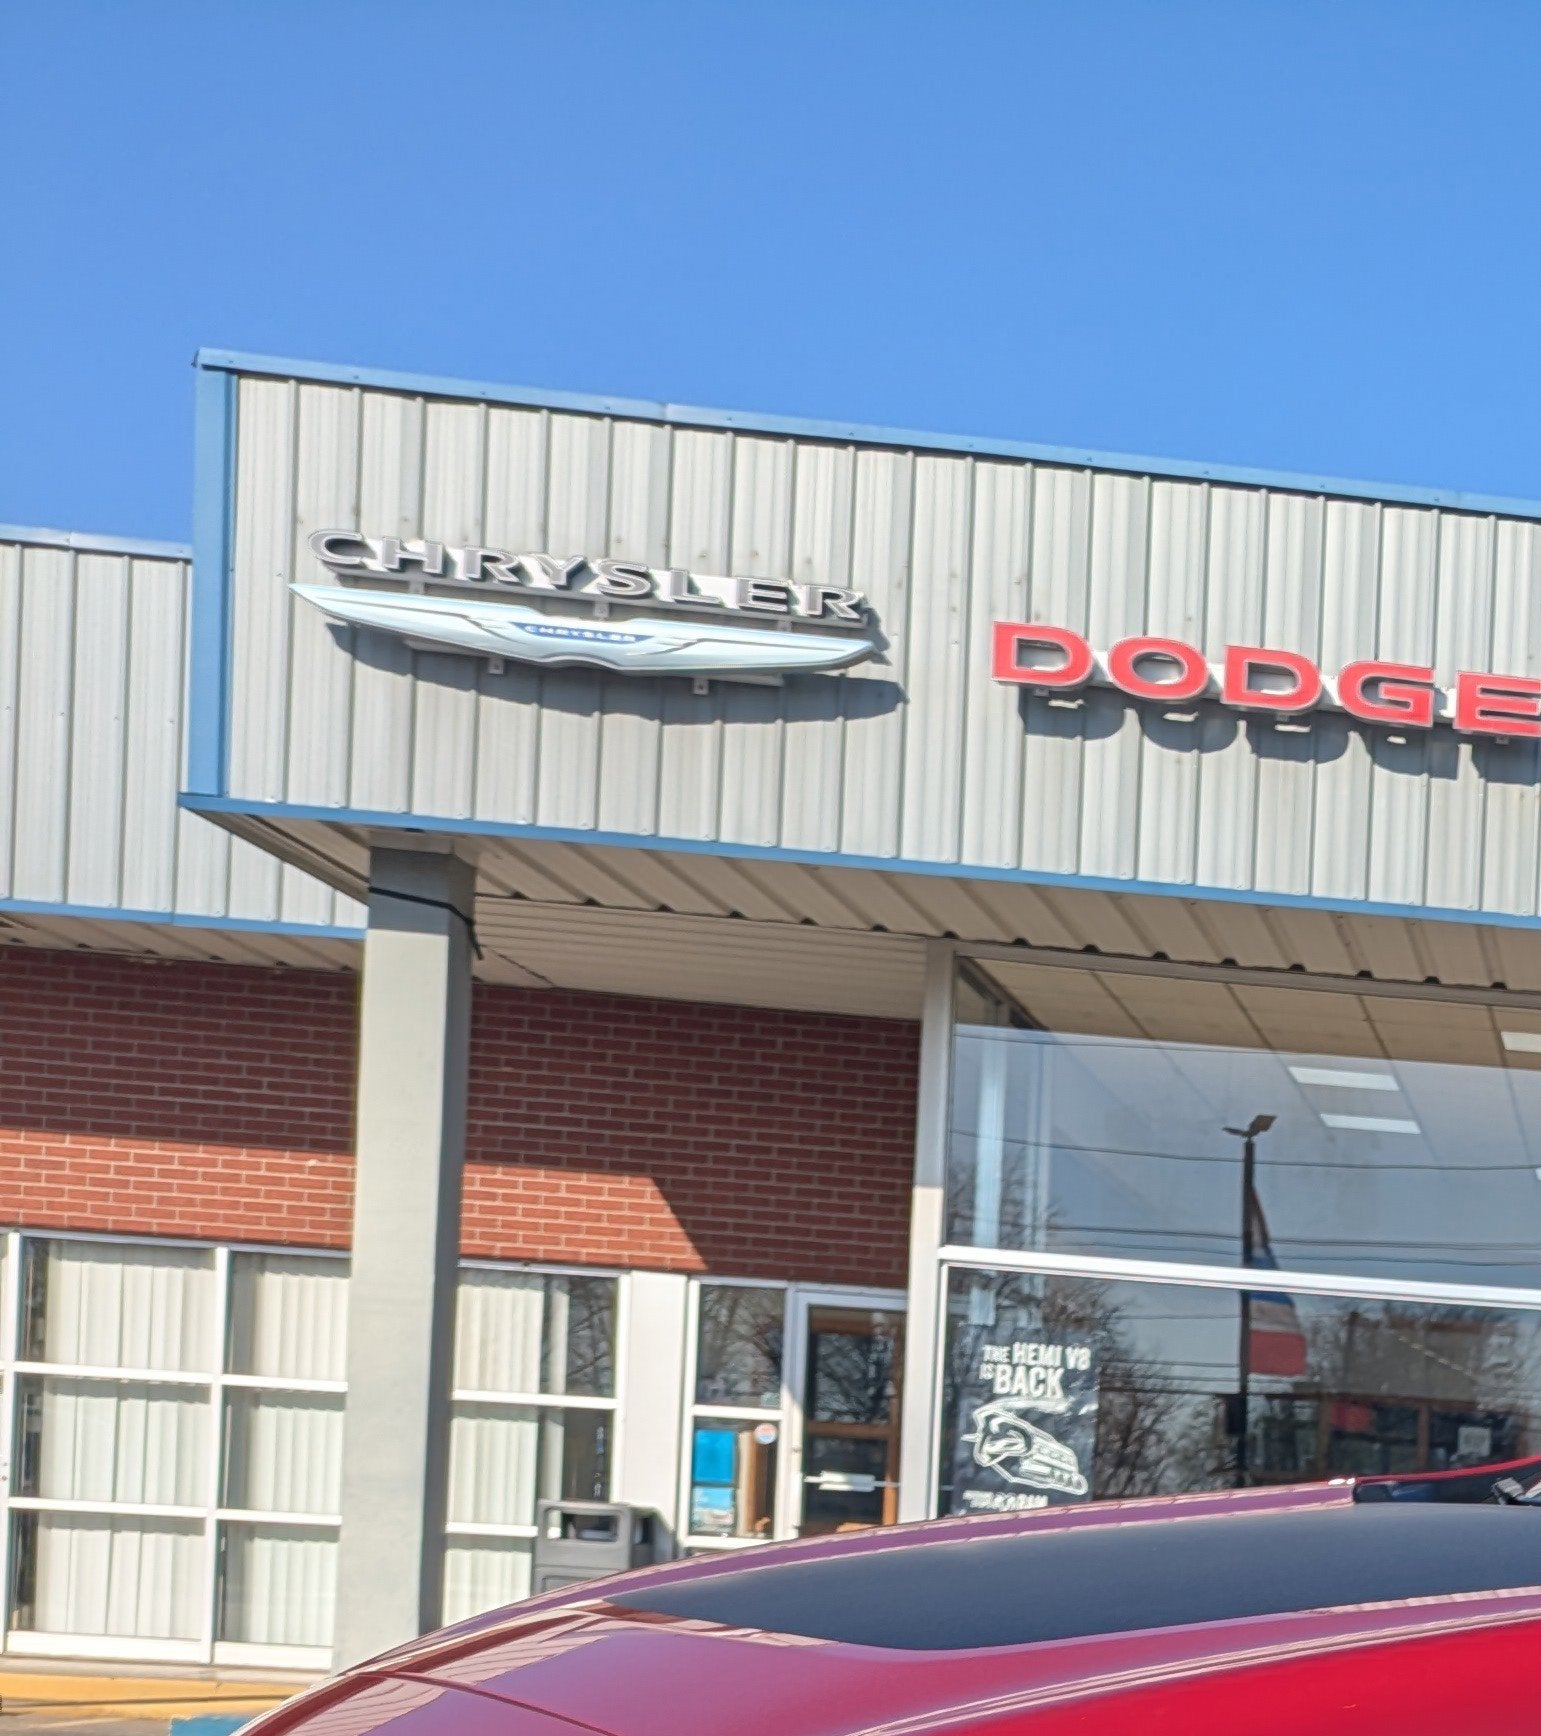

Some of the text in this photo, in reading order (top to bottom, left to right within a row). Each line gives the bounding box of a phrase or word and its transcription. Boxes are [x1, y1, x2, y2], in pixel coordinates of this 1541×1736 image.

[306, 528, 866, 621] CHRYSLER
[983, 1342, 1091, 1370] THE HEMI V8
[993, 1363, 1065, 1399] BACK
